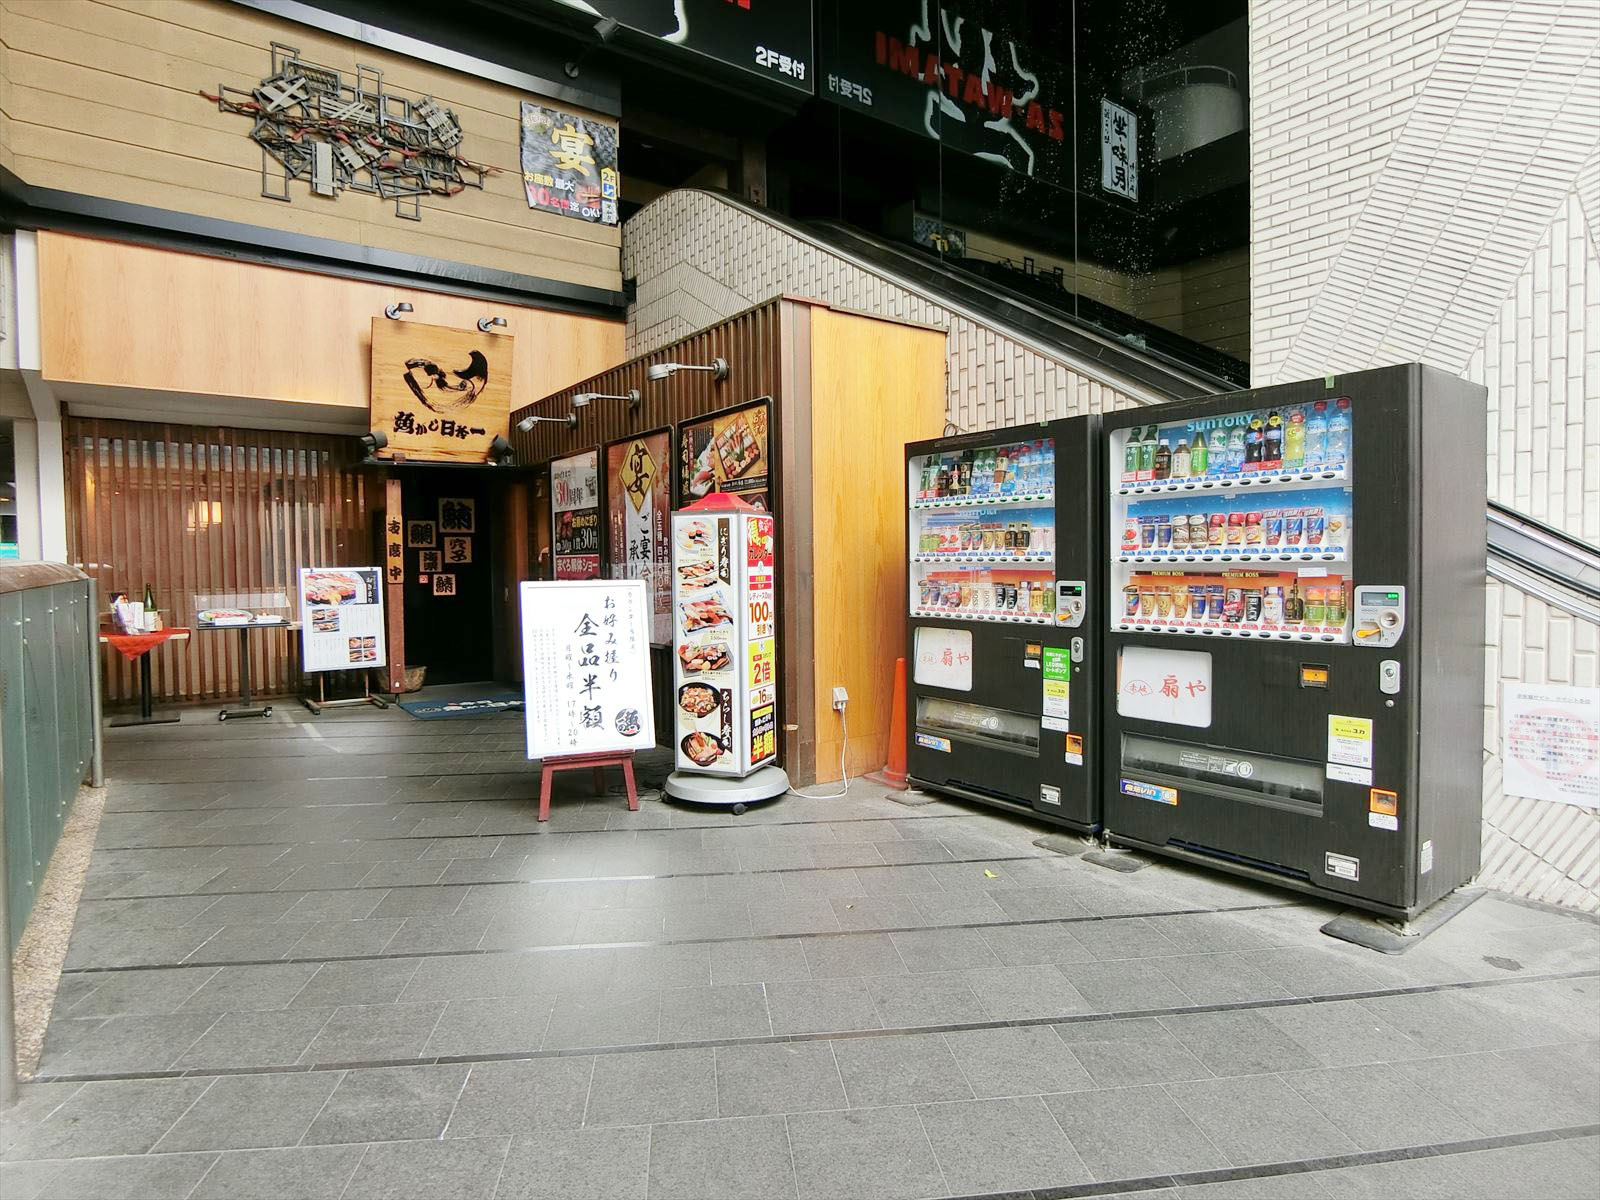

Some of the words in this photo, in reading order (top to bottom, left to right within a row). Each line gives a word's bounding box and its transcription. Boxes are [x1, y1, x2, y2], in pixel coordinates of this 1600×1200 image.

[755, 45, 805, 81] 2F受付
[549, 123, 595, 177] 宴
[627, 444, 649, 498] 宴
[449, 538, 467, 562] 穴子
[603, 595, 620, 682] お好み握り
[574, 613, 605, 731] 全品半額
[753, 661, 771, 684] 2倍
[1159, 674, 1207, 699] 扇や
